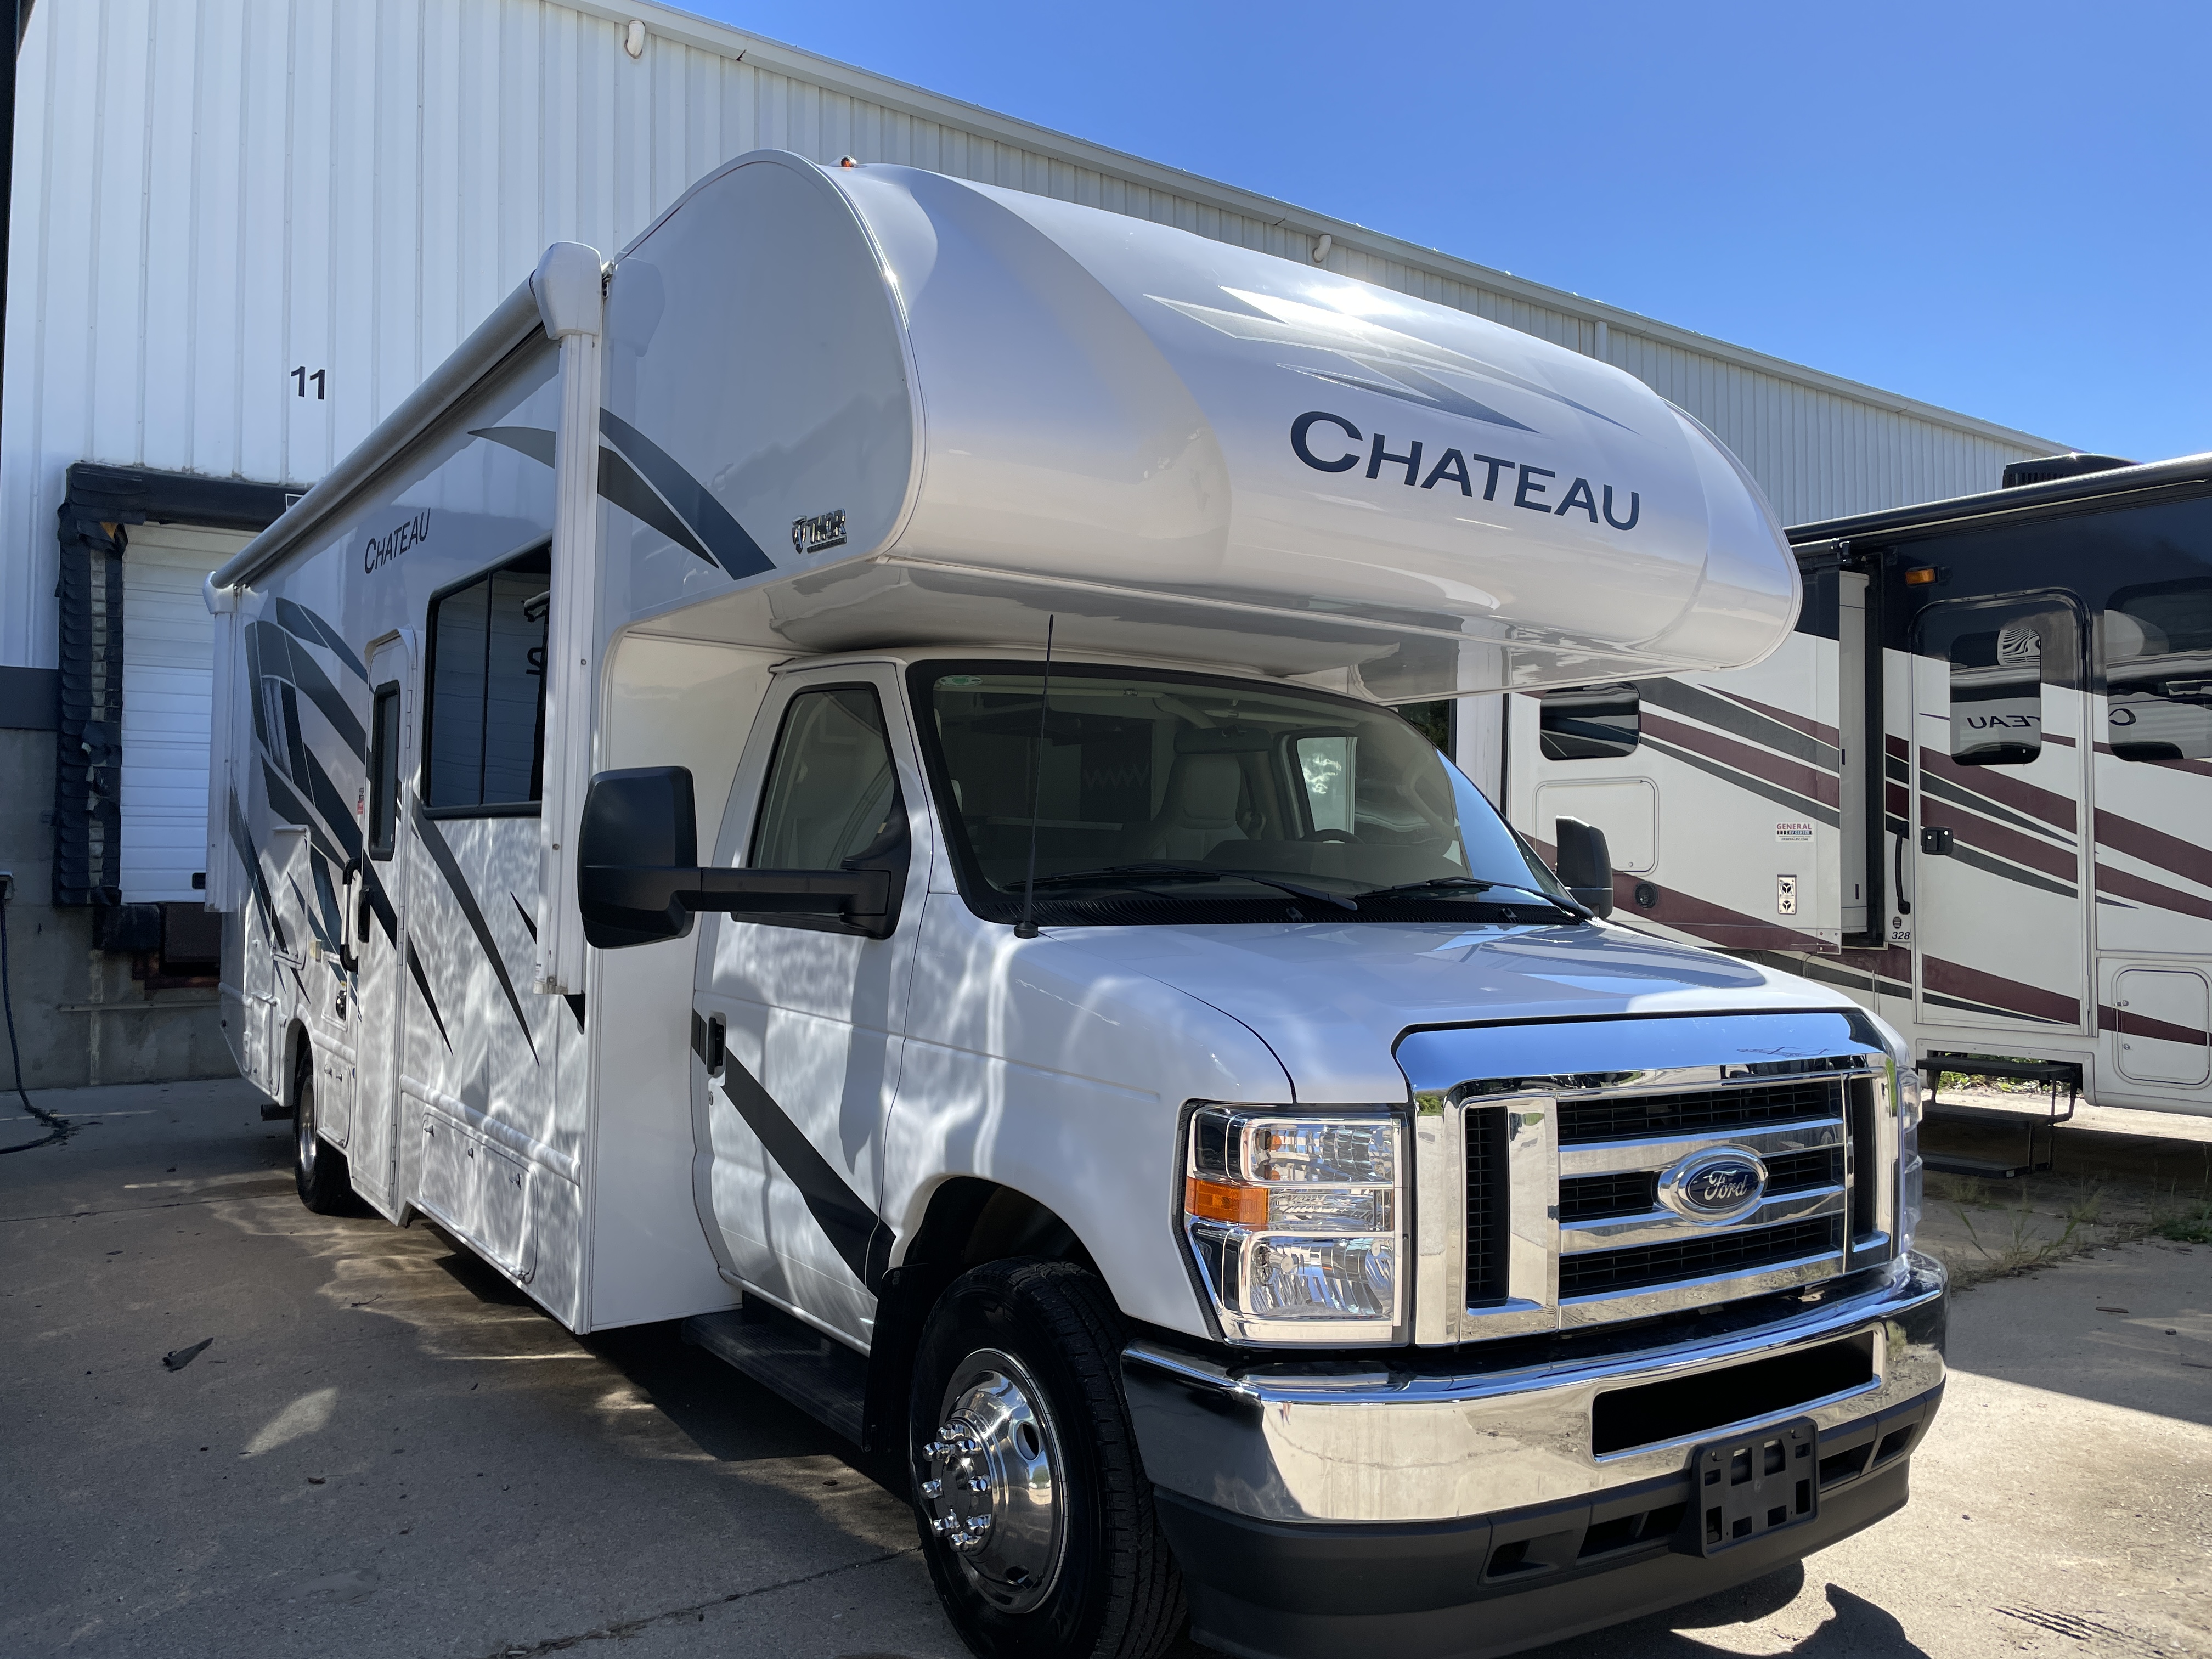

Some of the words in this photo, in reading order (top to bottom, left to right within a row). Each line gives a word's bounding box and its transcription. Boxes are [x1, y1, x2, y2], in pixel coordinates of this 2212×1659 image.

[291, 366, 325, 400] 11
[1290, 411, 1640, 531] CHATEAU
[364, 507, 431, 574] CHATEAU
[807, 508, 847, 544] THOR
[1703, 1169, 1748, 1201] Ford
